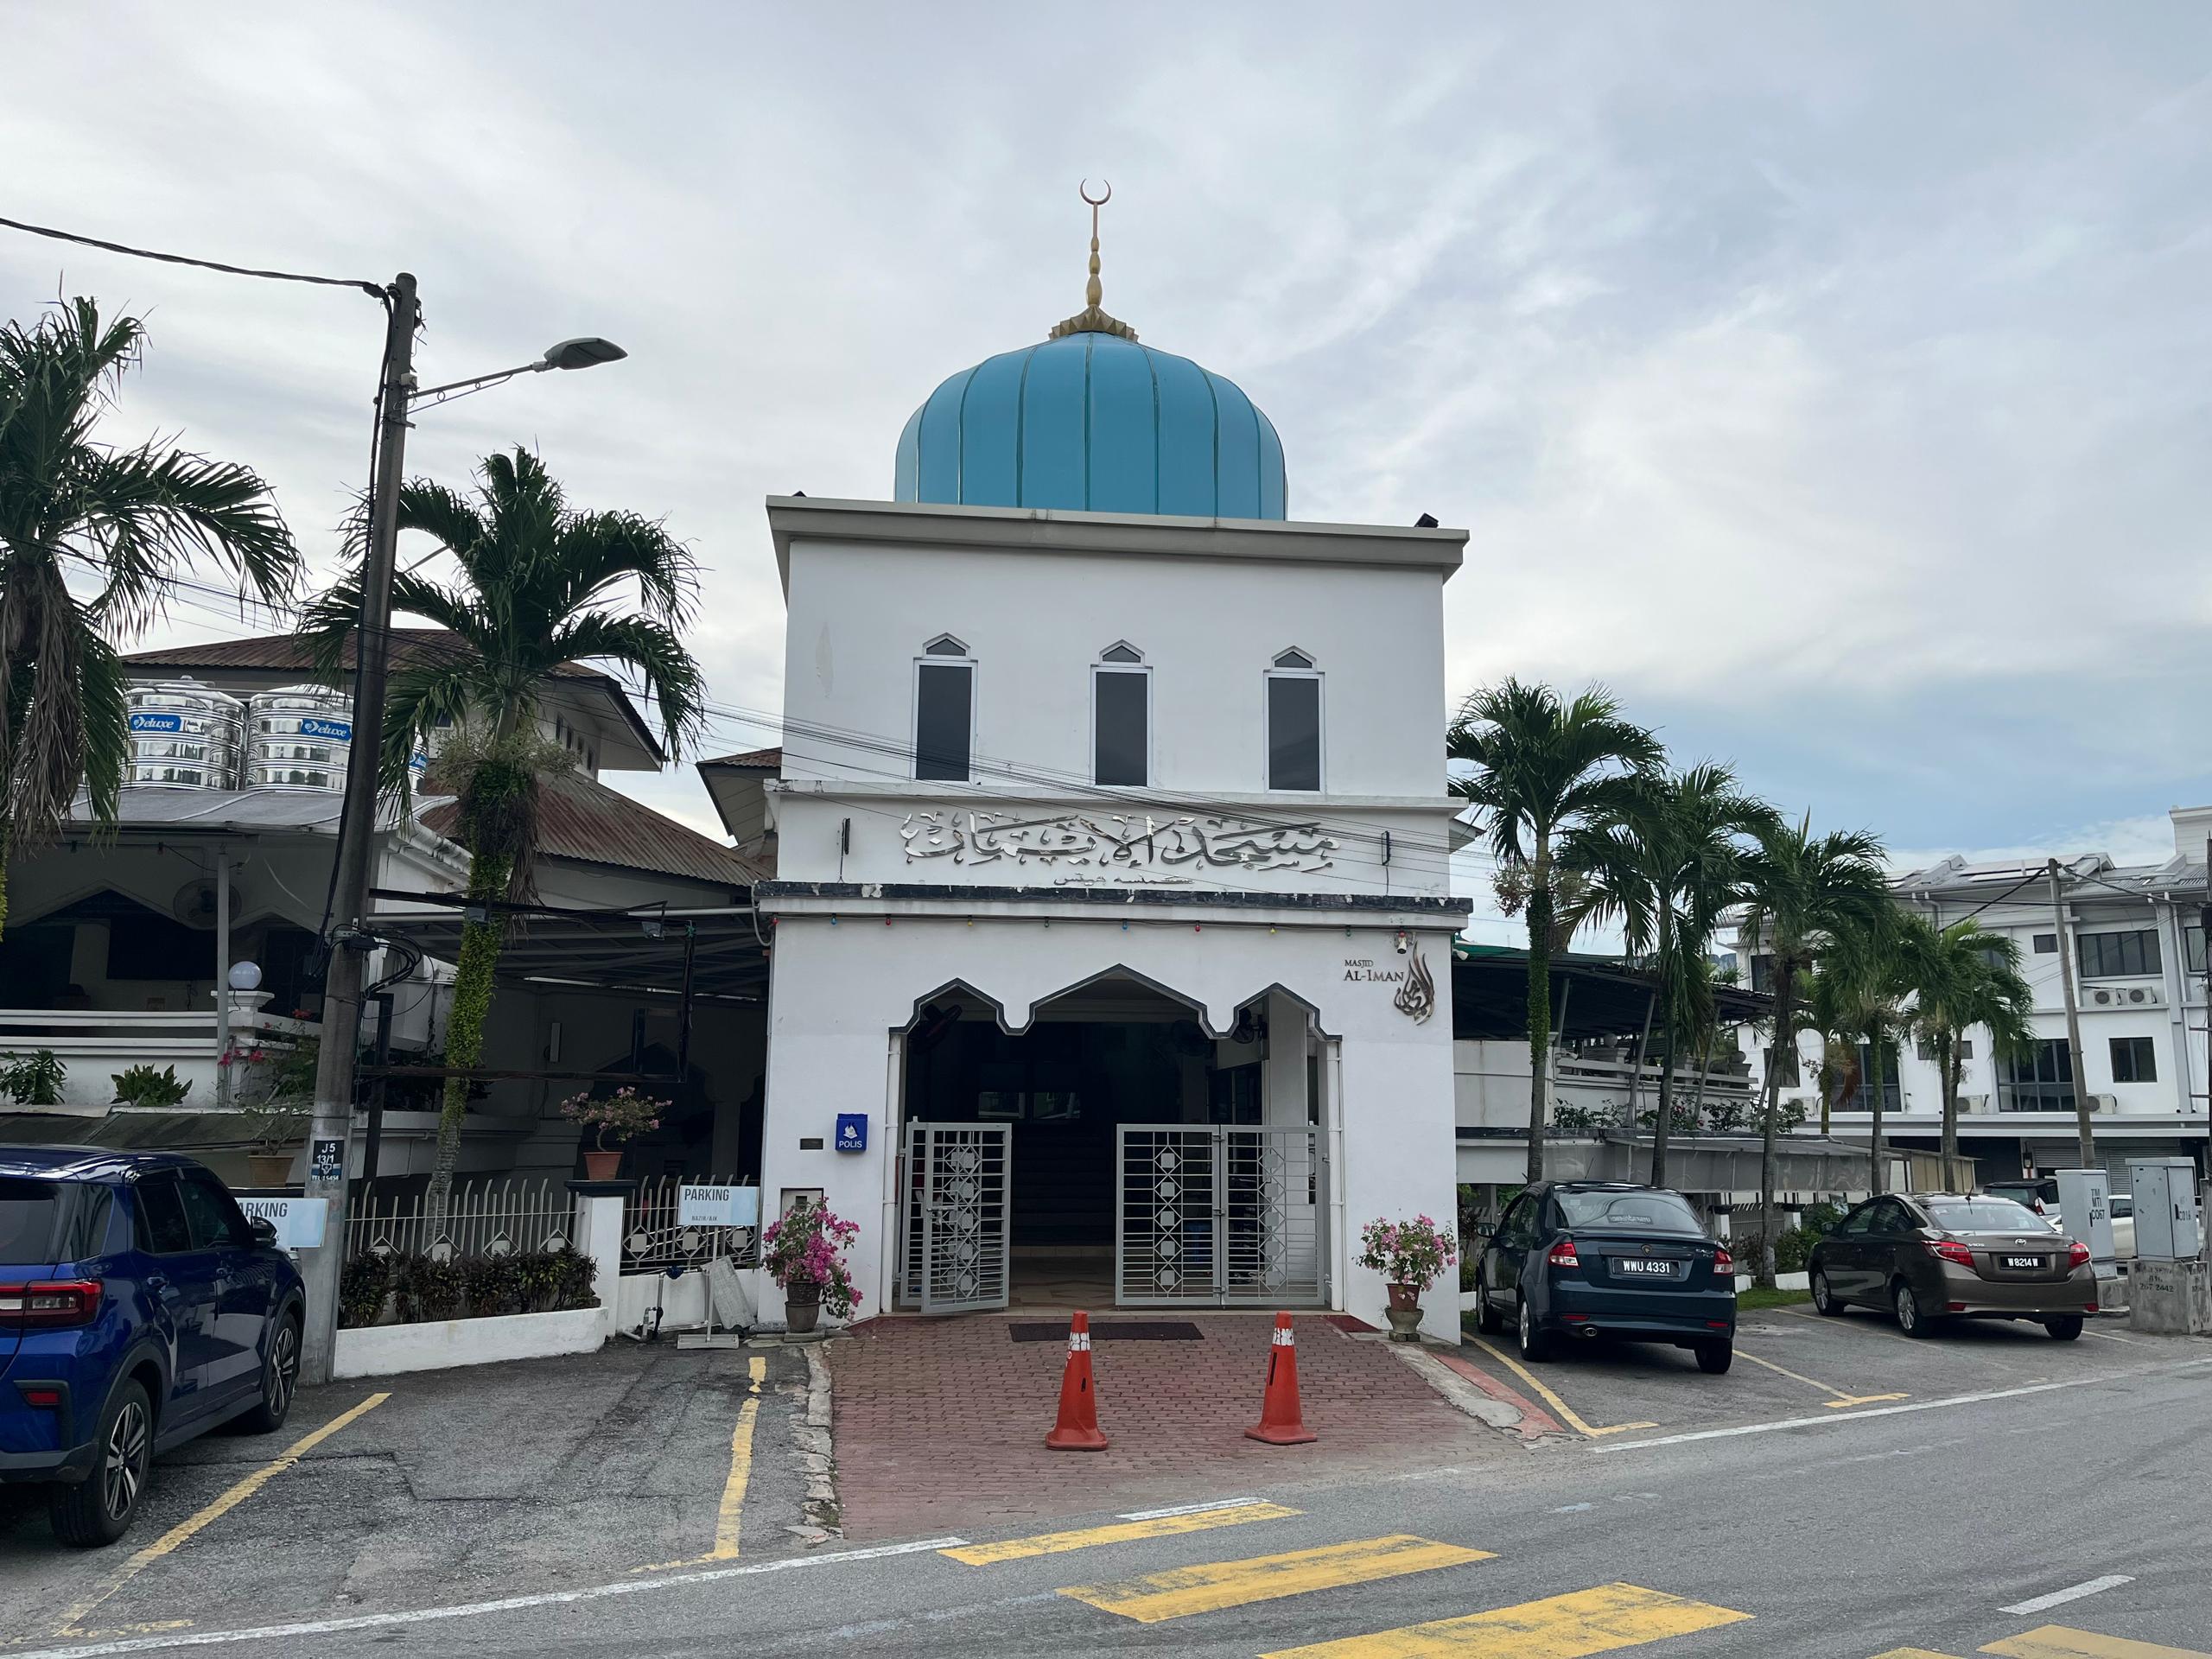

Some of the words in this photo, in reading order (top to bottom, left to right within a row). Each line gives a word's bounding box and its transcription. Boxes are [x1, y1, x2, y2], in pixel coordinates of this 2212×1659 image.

[133, 716, 174, 730] Deluxe
[304, 721, 346, 737] Deluxe
[1344, 959, 1374, 969] MASJID
[316, 1154, 334, 1165] 13/1
[684, 1188, 730, 1202] PARKING
[238, 1202, 288, 1217] ARKING
[1623, 1260, 1643, 1272] WWU
[1646, 1261, 1670, 1274] 4331
